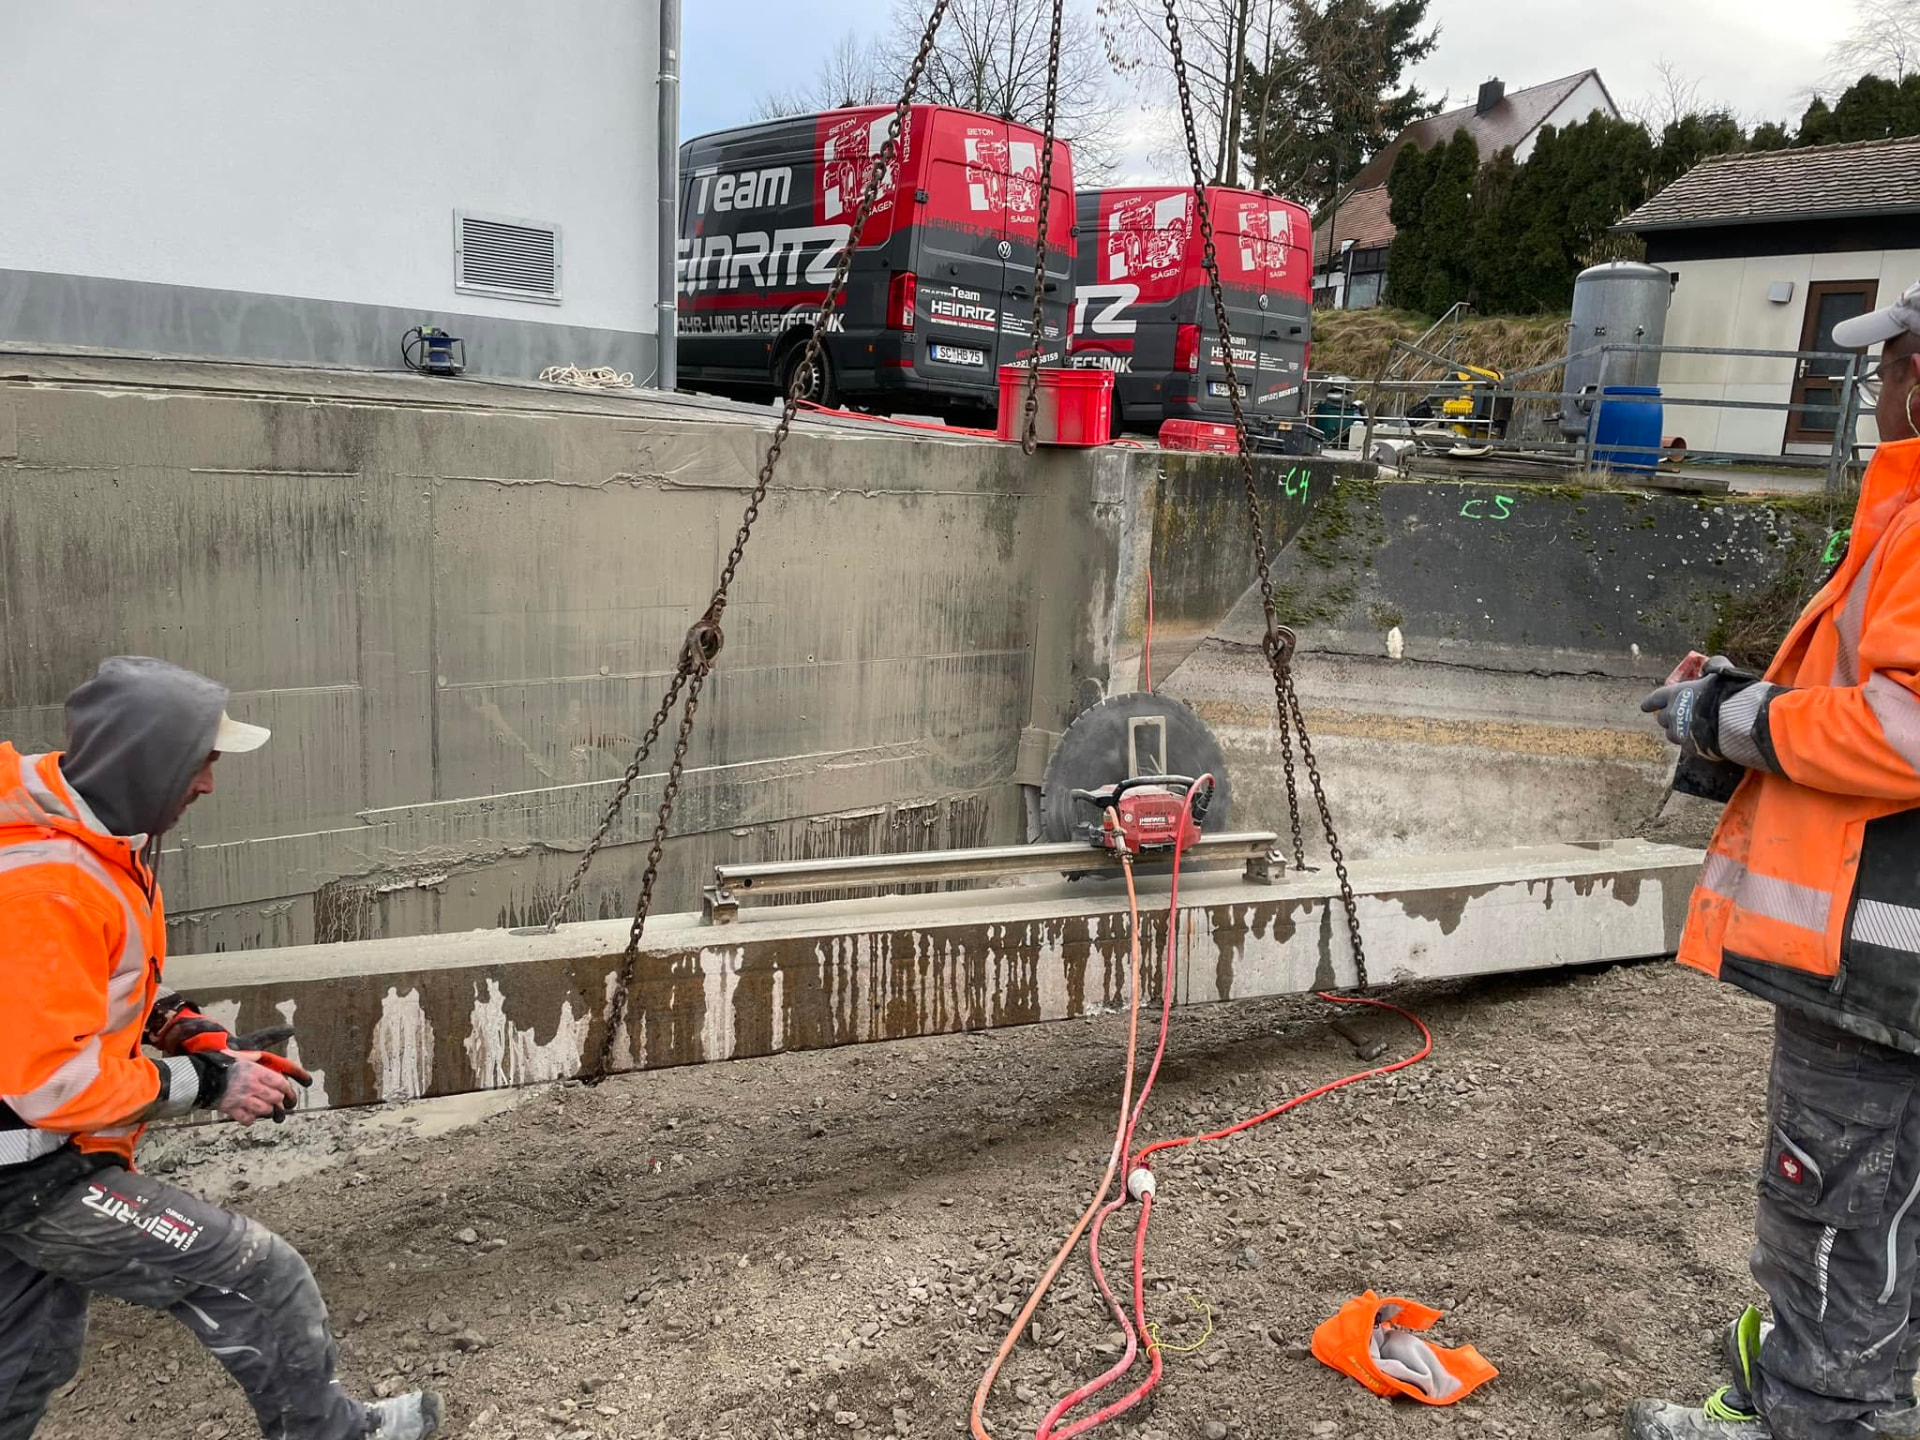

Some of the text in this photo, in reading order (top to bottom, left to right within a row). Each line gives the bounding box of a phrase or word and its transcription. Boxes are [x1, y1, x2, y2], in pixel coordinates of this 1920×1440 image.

[828, 117, 857, 136] BETON
[966, 128, 994, 136] BETON
[695, 166, 792, 214] Team
[1113, 196, 1142, 210] BETON
[950, 286, 980, 302] Team
[709, 315, 738, 333] UND
[939, 347, 952, 358] SC
[957, 349, 969, 360] HB
[970, 351, 981, 362] 75
[1285, 467, 1312, 505] C4
